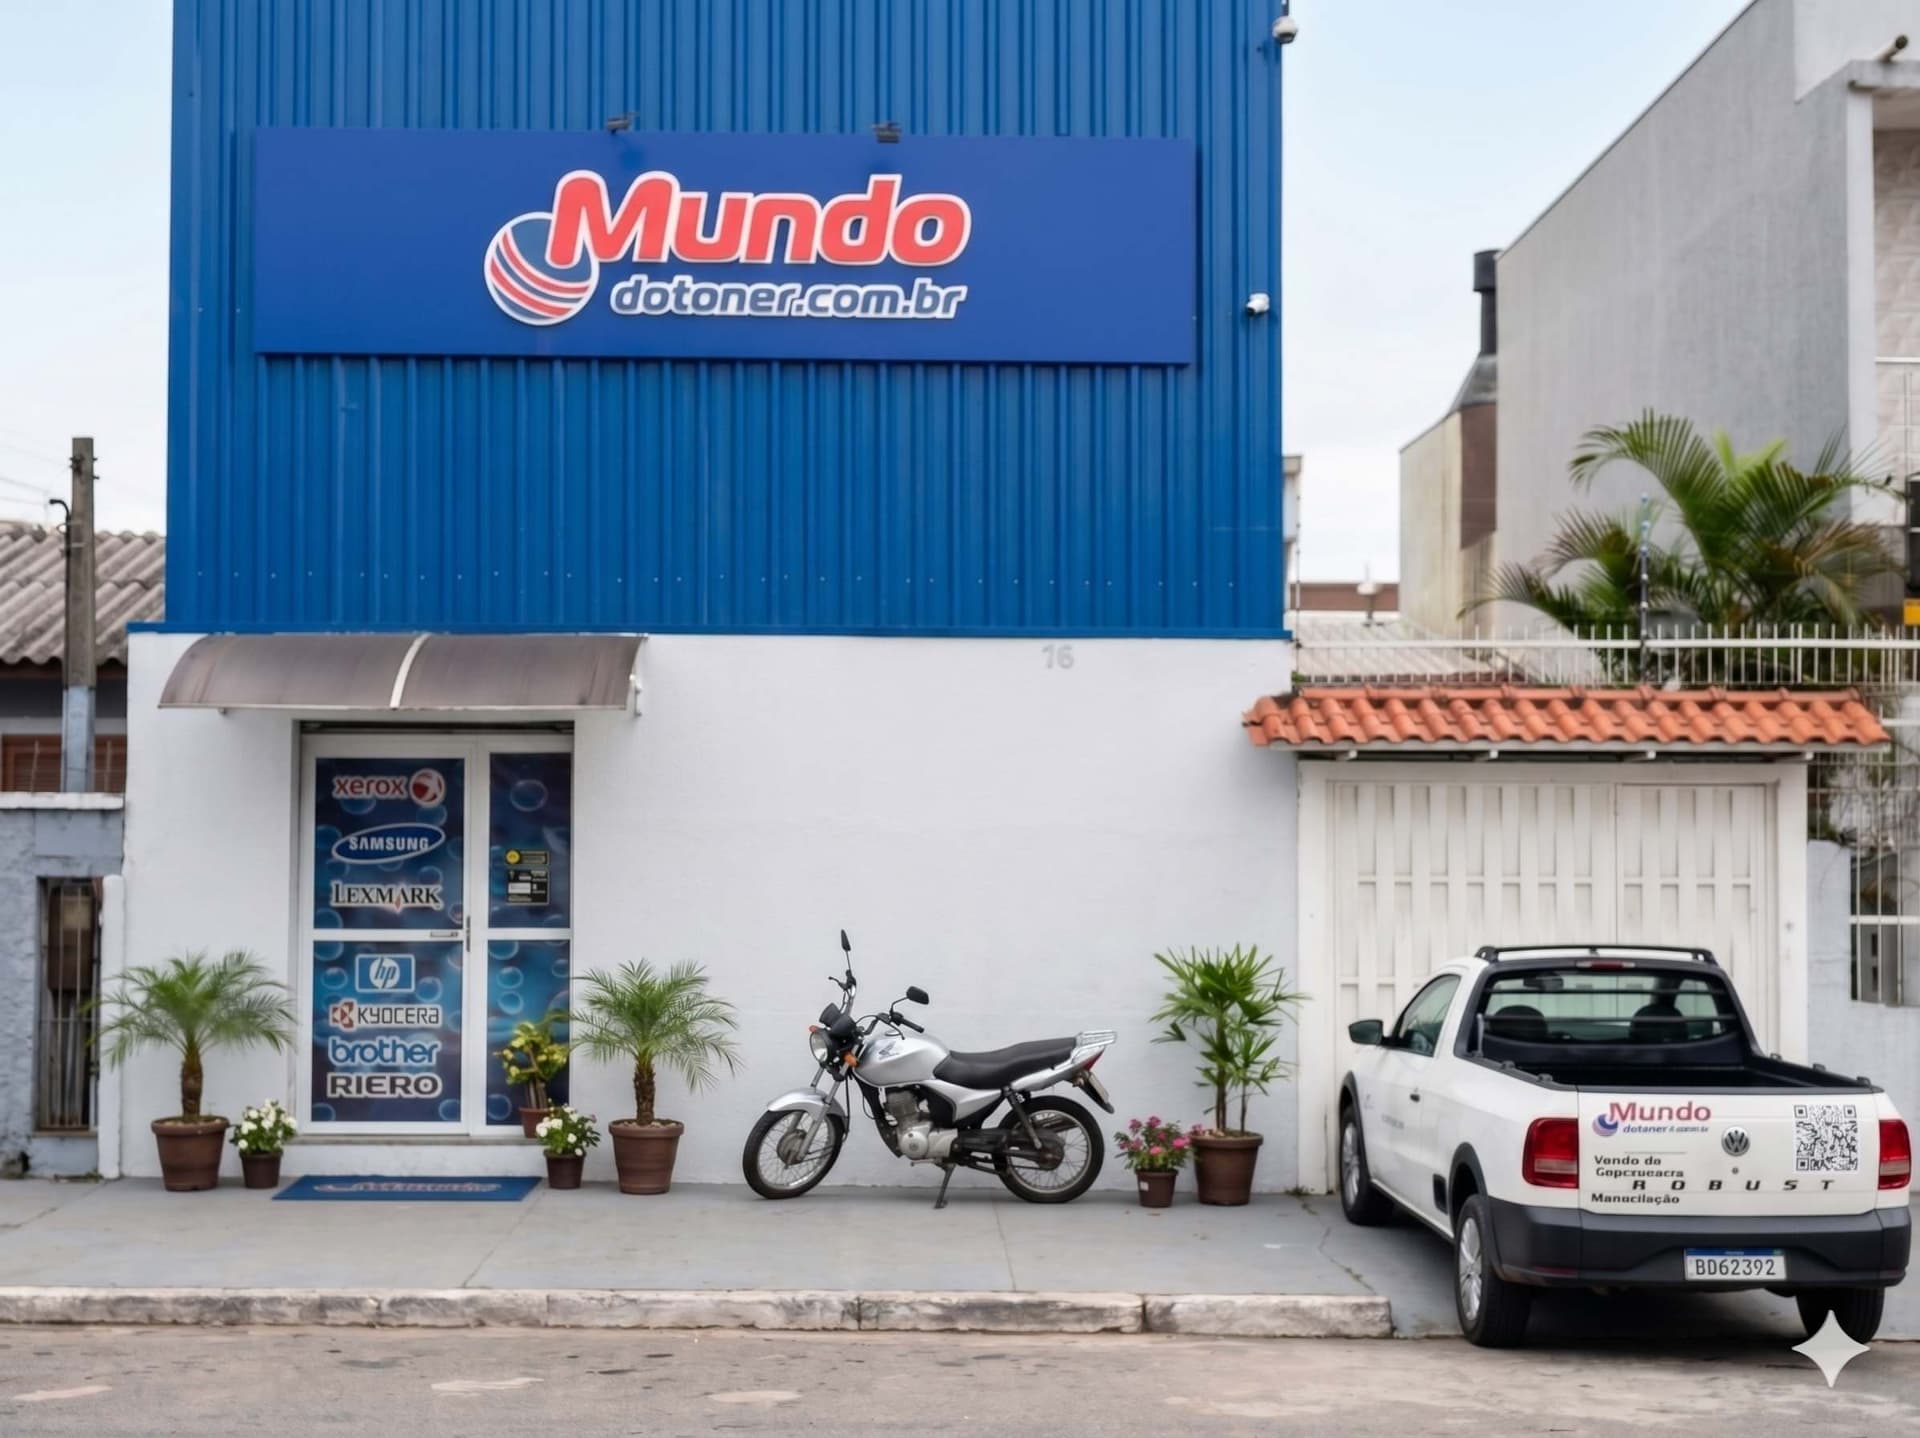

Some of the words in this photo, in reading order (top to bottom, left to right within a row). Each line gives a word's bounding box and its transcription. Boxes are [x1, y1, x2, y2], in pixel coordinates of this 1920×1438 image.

[546, 170, 972, 268] Mundo
[610, 274, 968, 319] dotoner.com.br
[1042, 645, 1074, 669] 16
[335, 778, 405, 796] xerox
[349, 837, 429, 851] SAMSUNG
[334, 883, 440, 906] LEXMARK
[374, 957, 397, 989] hp
[331, 1039, 439, 1063] brother
[330, 1075, 439, 1095] RIERO
[1609, 1101, 1711, 1122] Mundo
[1632, 1180, 1834, 1191] ROBUST
[1695, 1259, 1776, 1275] BD62392
